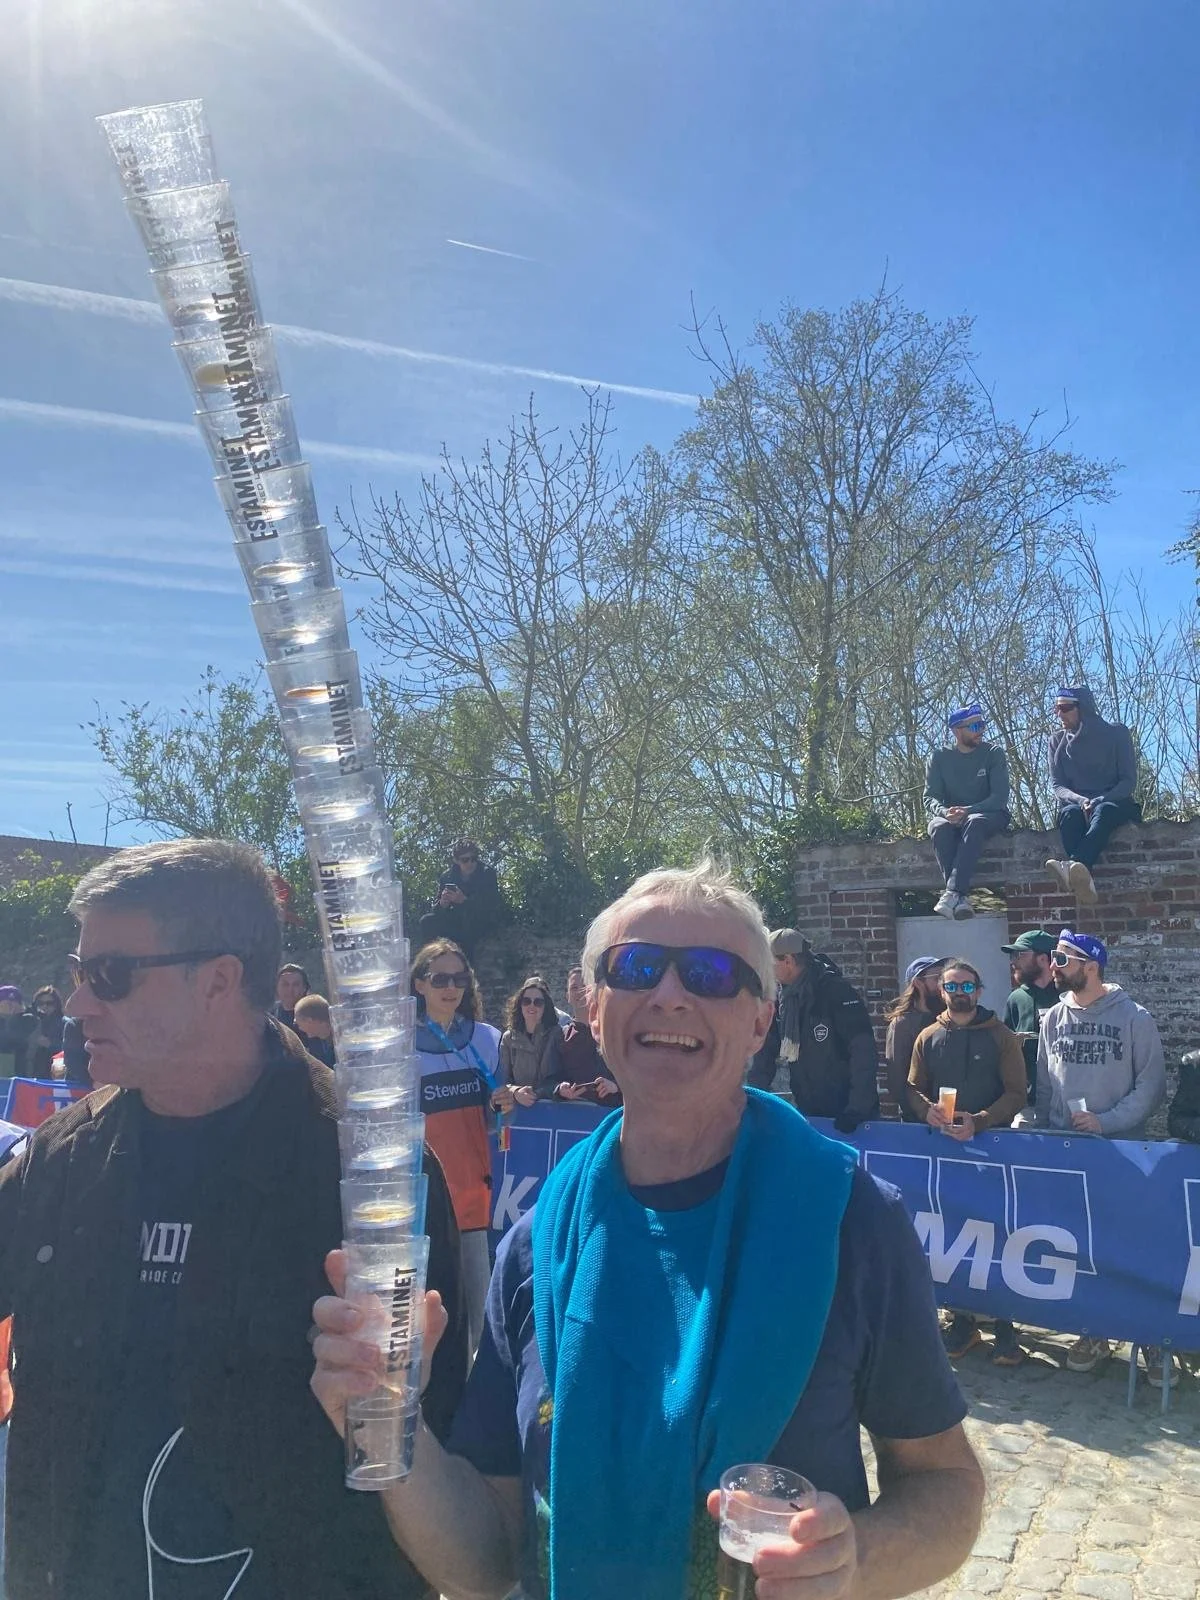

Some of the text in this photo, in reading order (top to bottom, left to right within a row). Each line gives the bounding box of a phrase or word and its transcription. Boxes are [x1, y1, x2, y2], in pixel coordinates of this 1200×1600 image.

[221, 435, 278, 541] ESTAMINET
[326, 679, 364, 776] ESTAMINET
[317, 860, 356, 951] ESTAMINET
[424, 1078, 480, 1100] Steward
[387, 1267, 417, 1373] ESTAMINET
